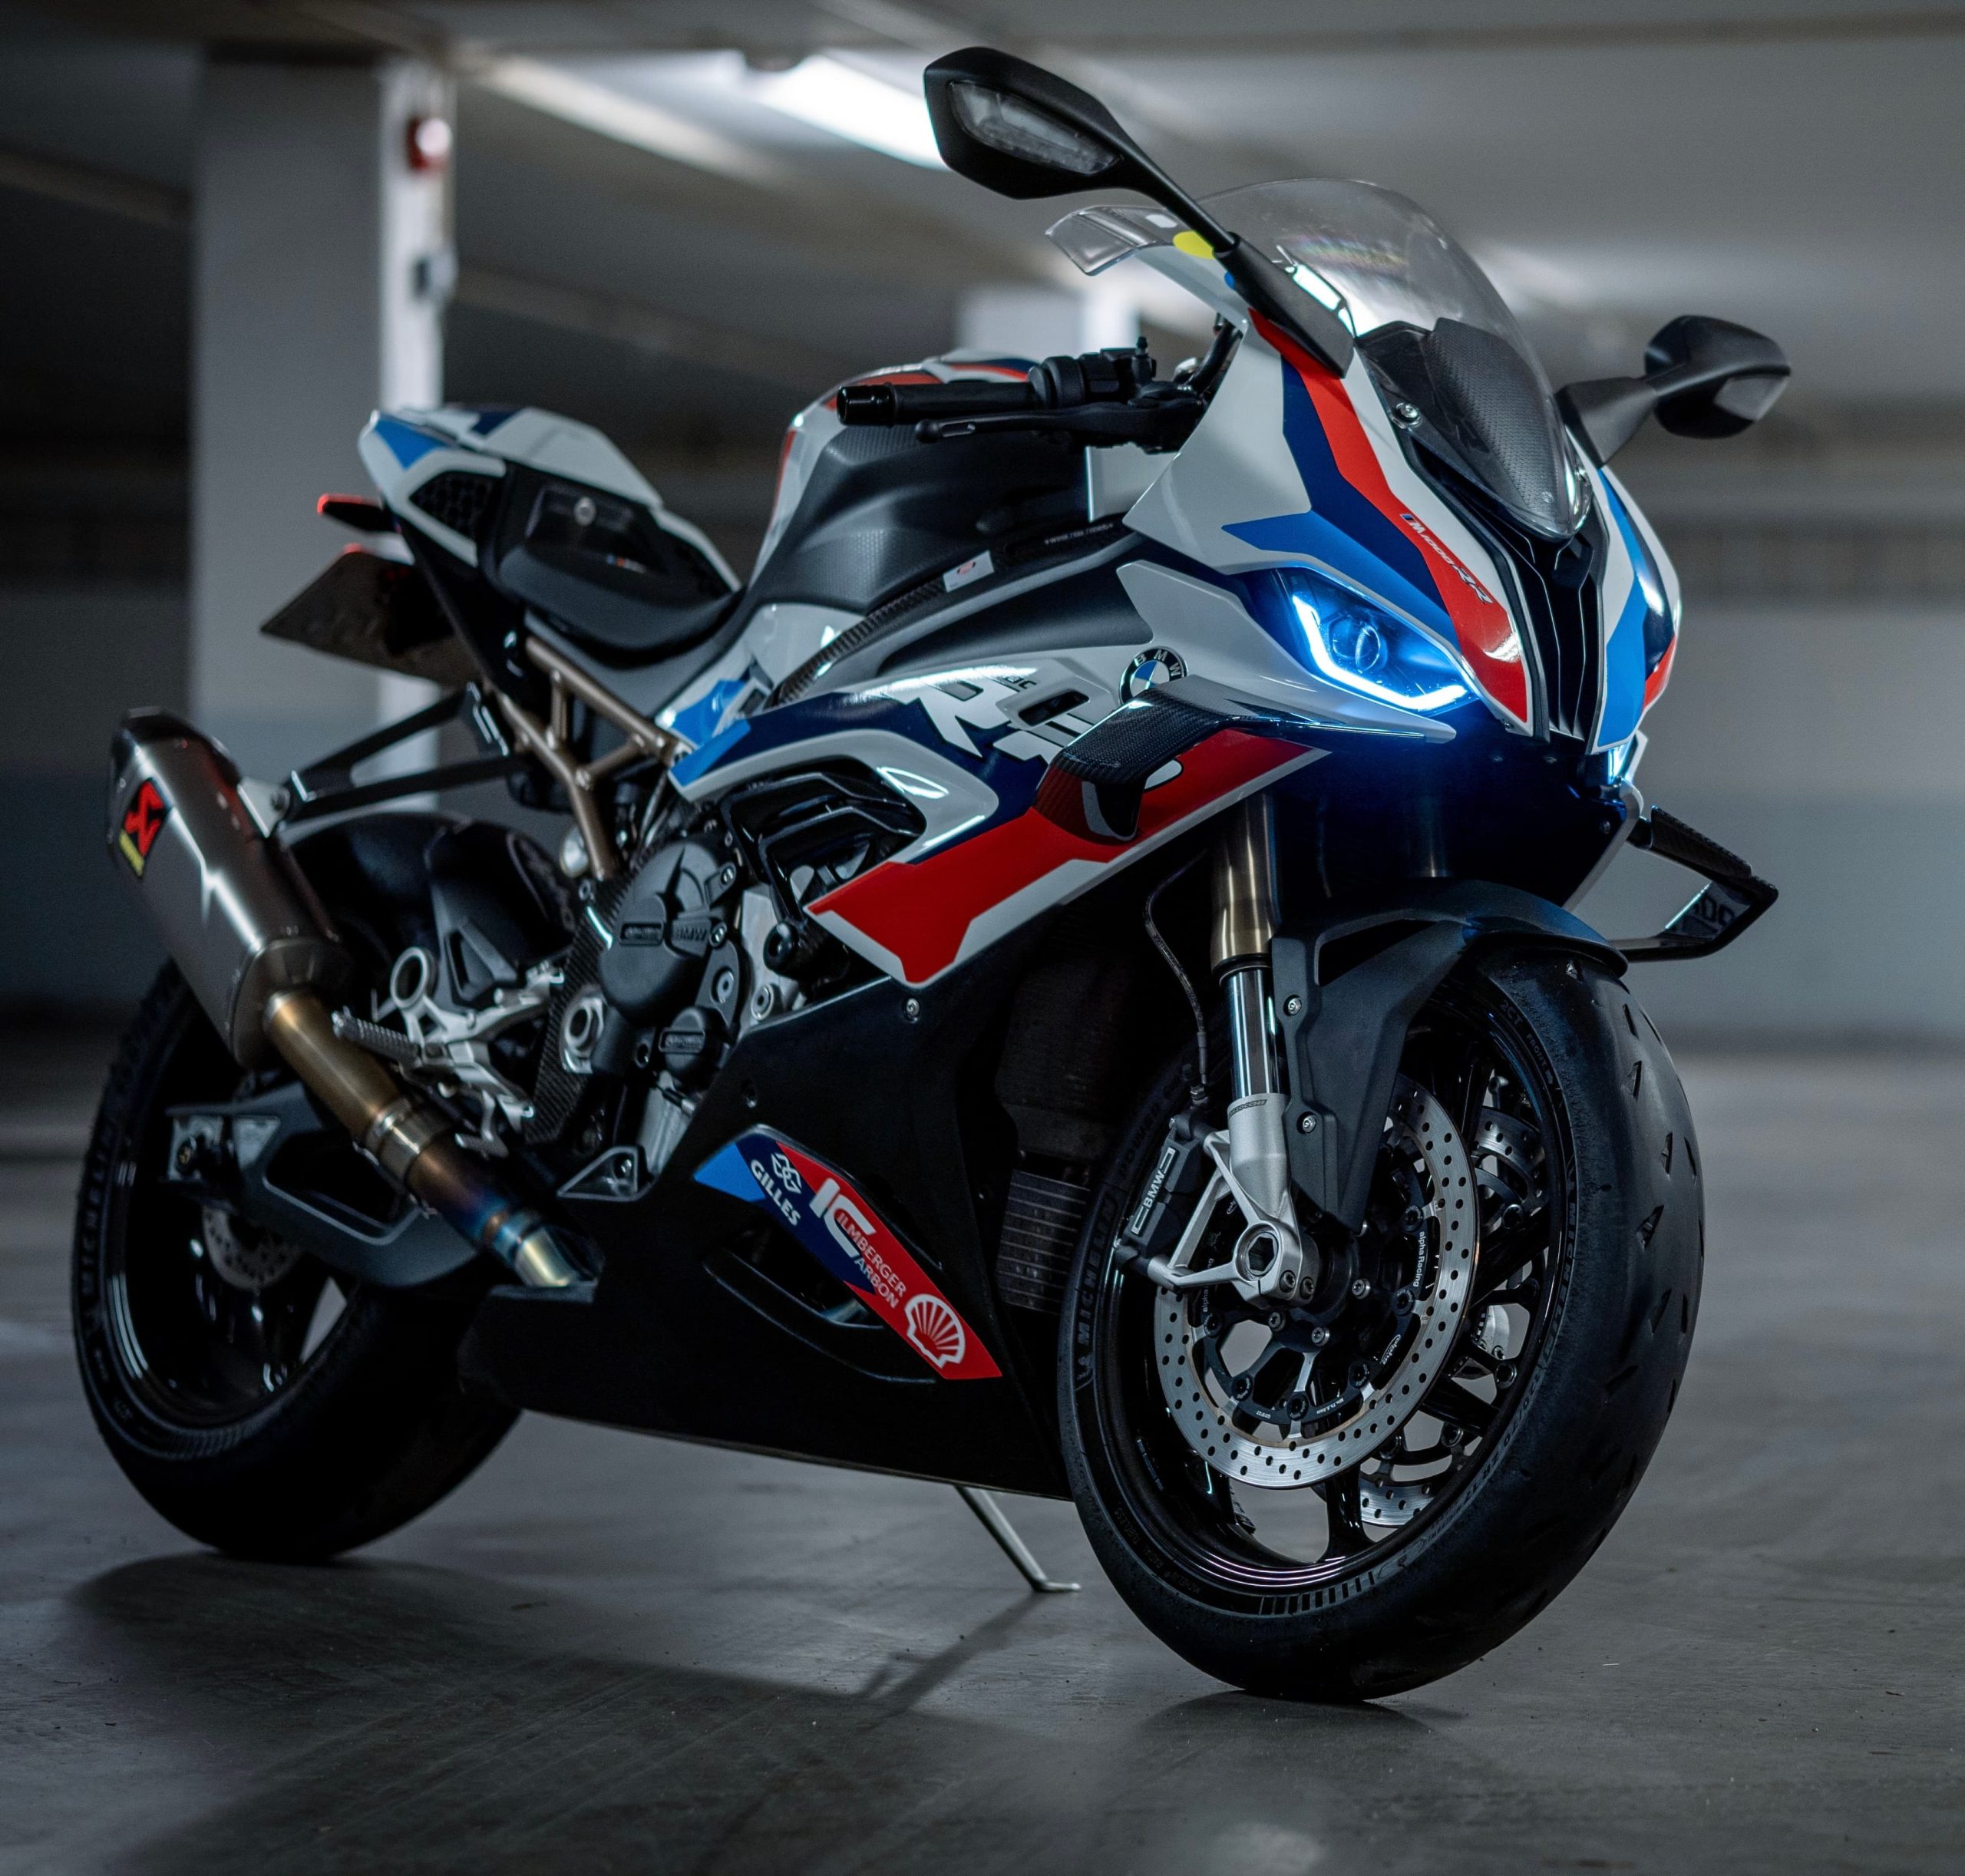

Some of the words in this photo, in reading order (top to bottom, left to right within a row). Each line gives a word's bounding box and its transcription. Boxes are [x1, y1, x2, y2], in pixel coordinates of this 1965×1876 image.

[1134, 649, 1181, 677] BMW
[750, 1159, 801, 1227] GILLES
[1143, 1170, 1166, 1209] BMW
[837, 1212, 907, 1297] ILMBERGER
